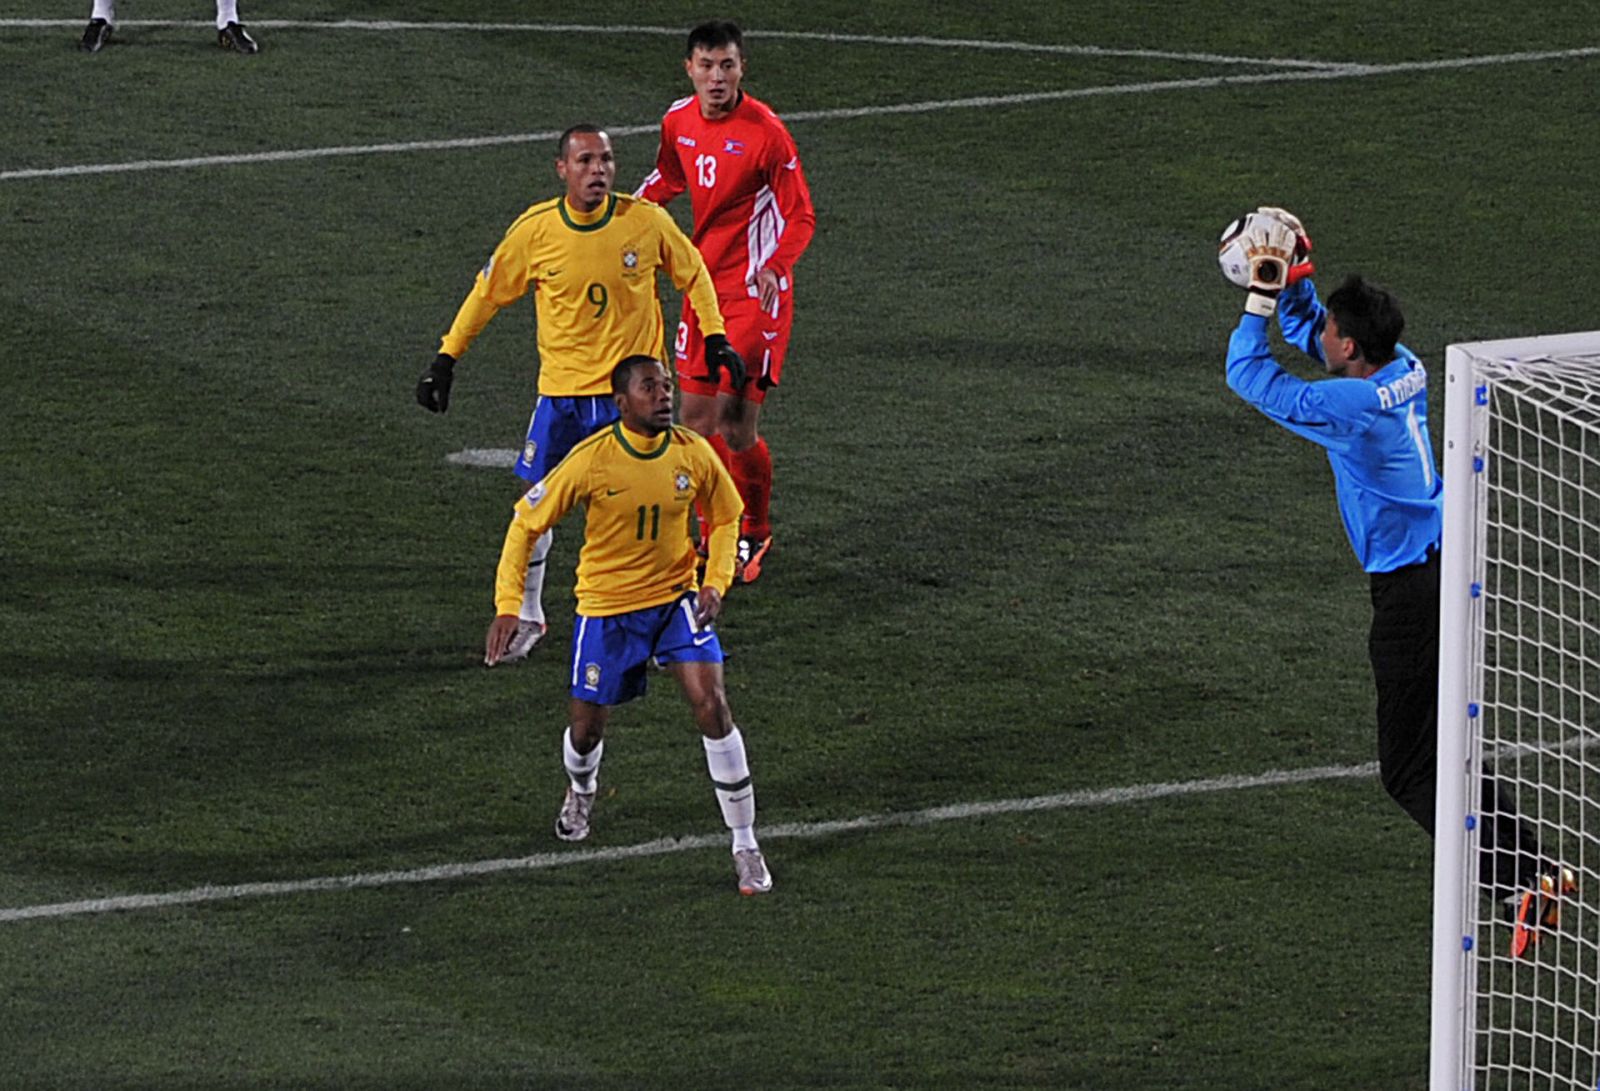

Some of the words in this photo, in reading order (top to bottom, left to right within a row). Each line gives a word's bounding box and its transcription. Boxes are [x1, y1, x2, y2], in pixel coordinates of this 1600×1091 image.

[695, 153, 717, 188] 13
[587, 282, 609, 319] 9
[636, 503, 660, 541] 11
[680, 598, 711, 634] 1
